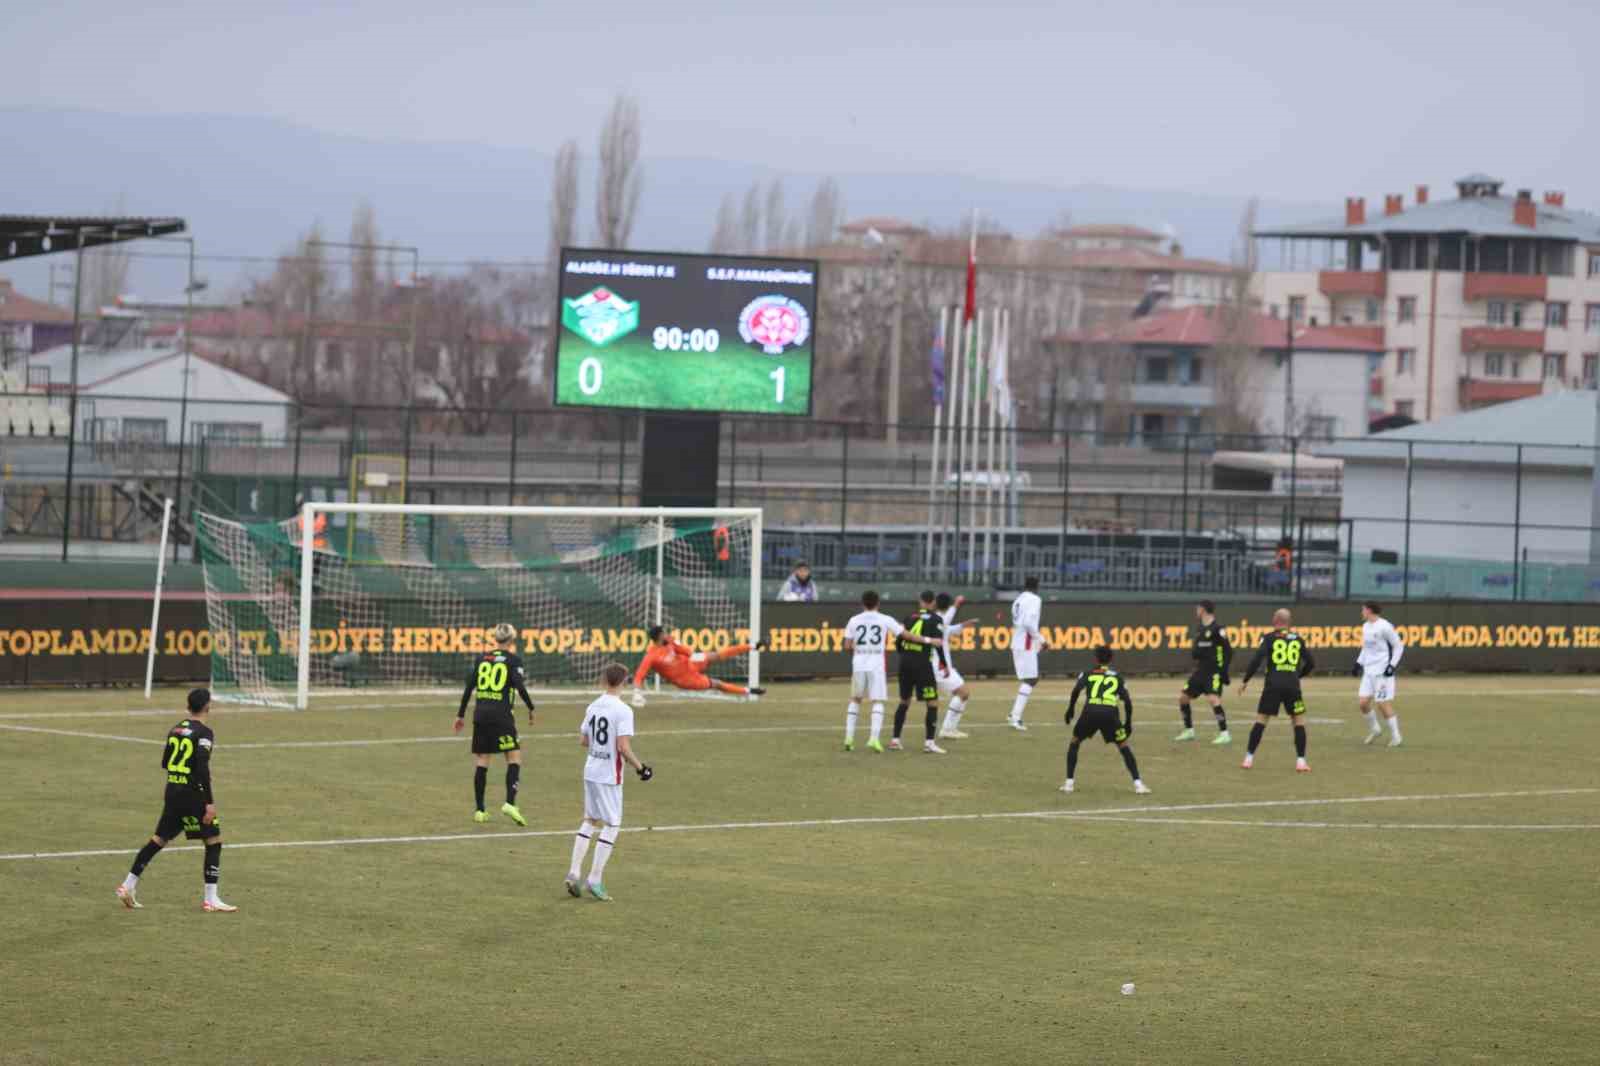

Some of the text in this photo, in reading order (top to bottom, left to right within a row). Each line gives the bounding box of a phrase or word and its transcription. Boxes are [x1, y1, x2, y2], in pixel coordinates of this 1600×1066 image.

[653, 326, 719, 352] 90:00
[578, 357, 602, 396] 0
[769, 366, 785, 403] 1
[0, 628, 158, 655] TOPLAMDA
[164, 629, 230, 655] 1000
[238, 630, 272, 655] TL
[392, 627, 516, 653] HERKES
[521, 628, 653, 652] TOPLAMD
[769, 621, 847, 652] HEDİY
[979, 625, 1105, 651] TOAMDA
[1109, 626, 1162, 650] 1000
[1165, 625, 1193, 649] TL
[1393, 625, 1493, 649] OPLAMDA
[1496, 625, 1543, 648] 1000
[1546, 626, 1570, 648] TL
[856, 624, 882, 645] 23
[1271, 639, 1300, 665] 86
[478, 661, 508, 691] 80
[1087, 674, 1118, 701] 72
[588, 714, 609, 745] 18
[167, 736, 193, 773] 22
